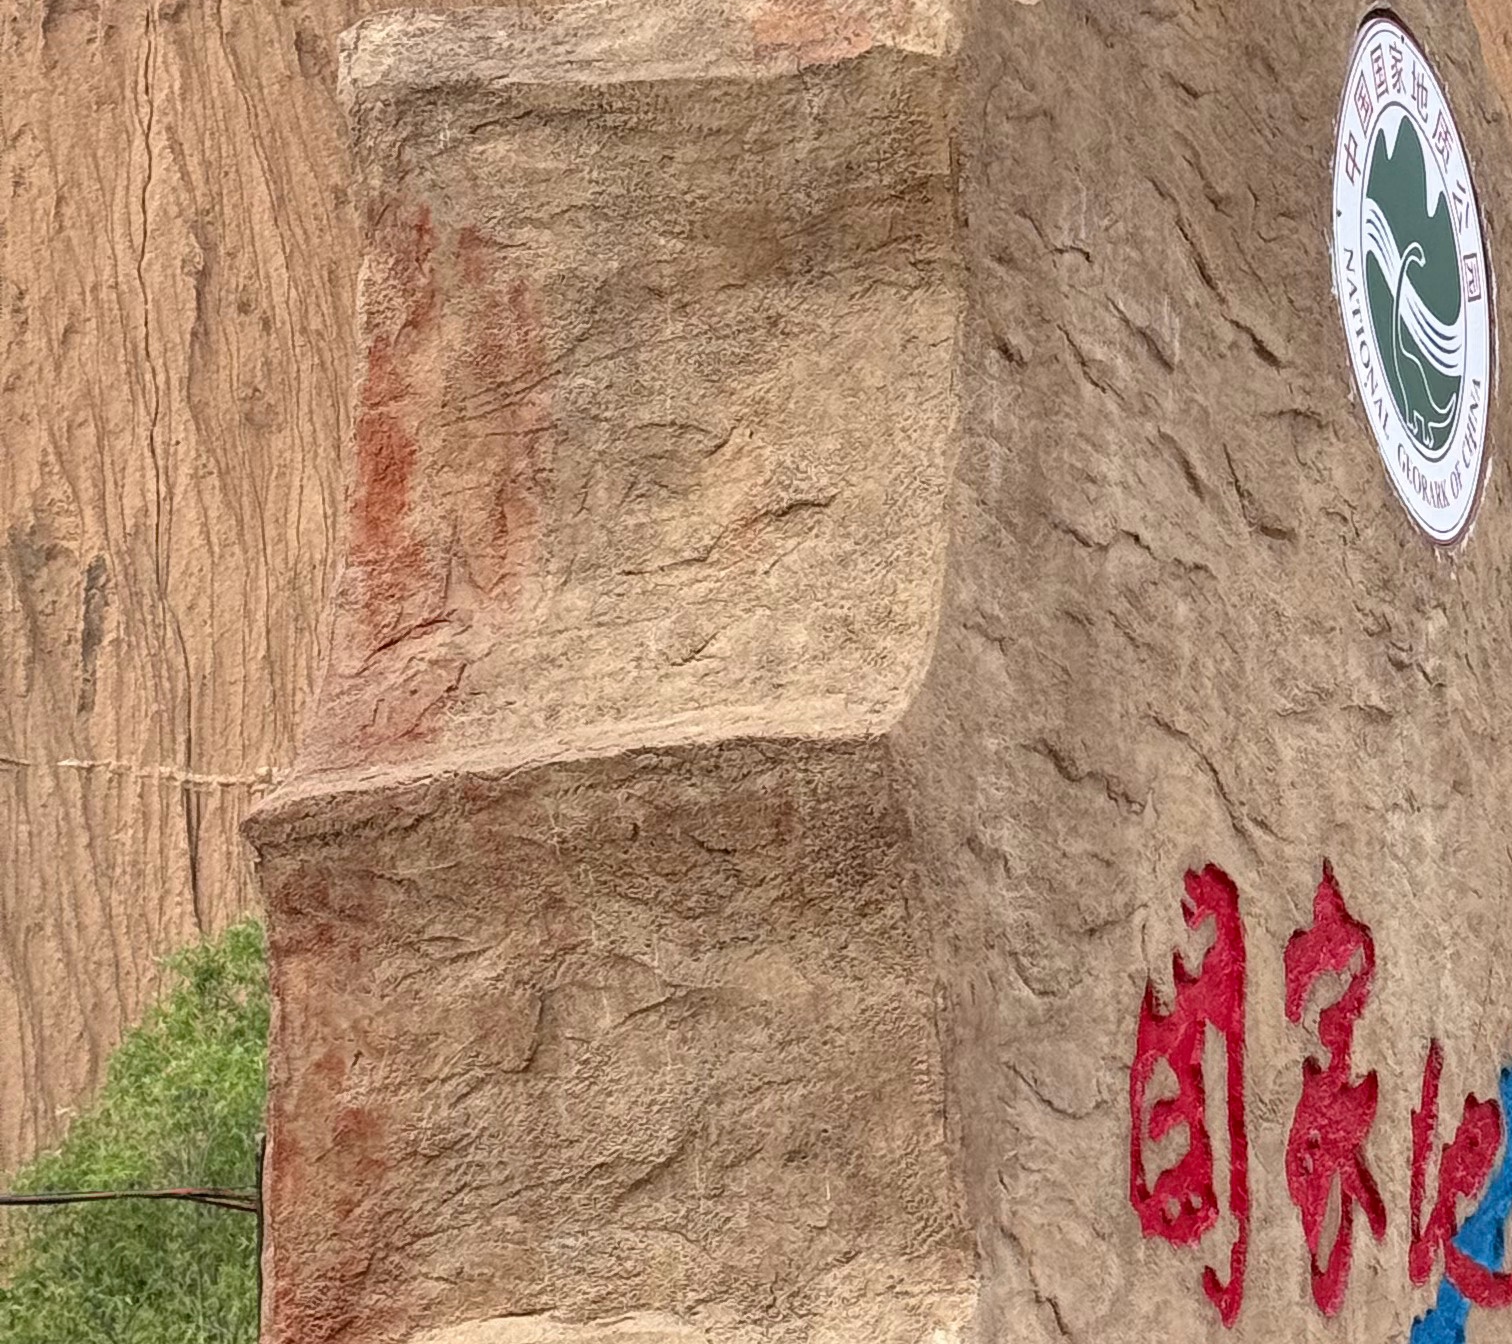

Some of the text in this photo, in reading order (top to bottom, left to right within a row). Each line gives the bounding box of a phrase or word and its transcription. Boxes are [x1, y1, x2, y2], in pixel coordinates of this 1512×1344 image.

[1344, 247, 1389, 440] NATIONAL
[1449, 460, 1464, 500] OF
[1461, 378, 1482, 469] CHINA
